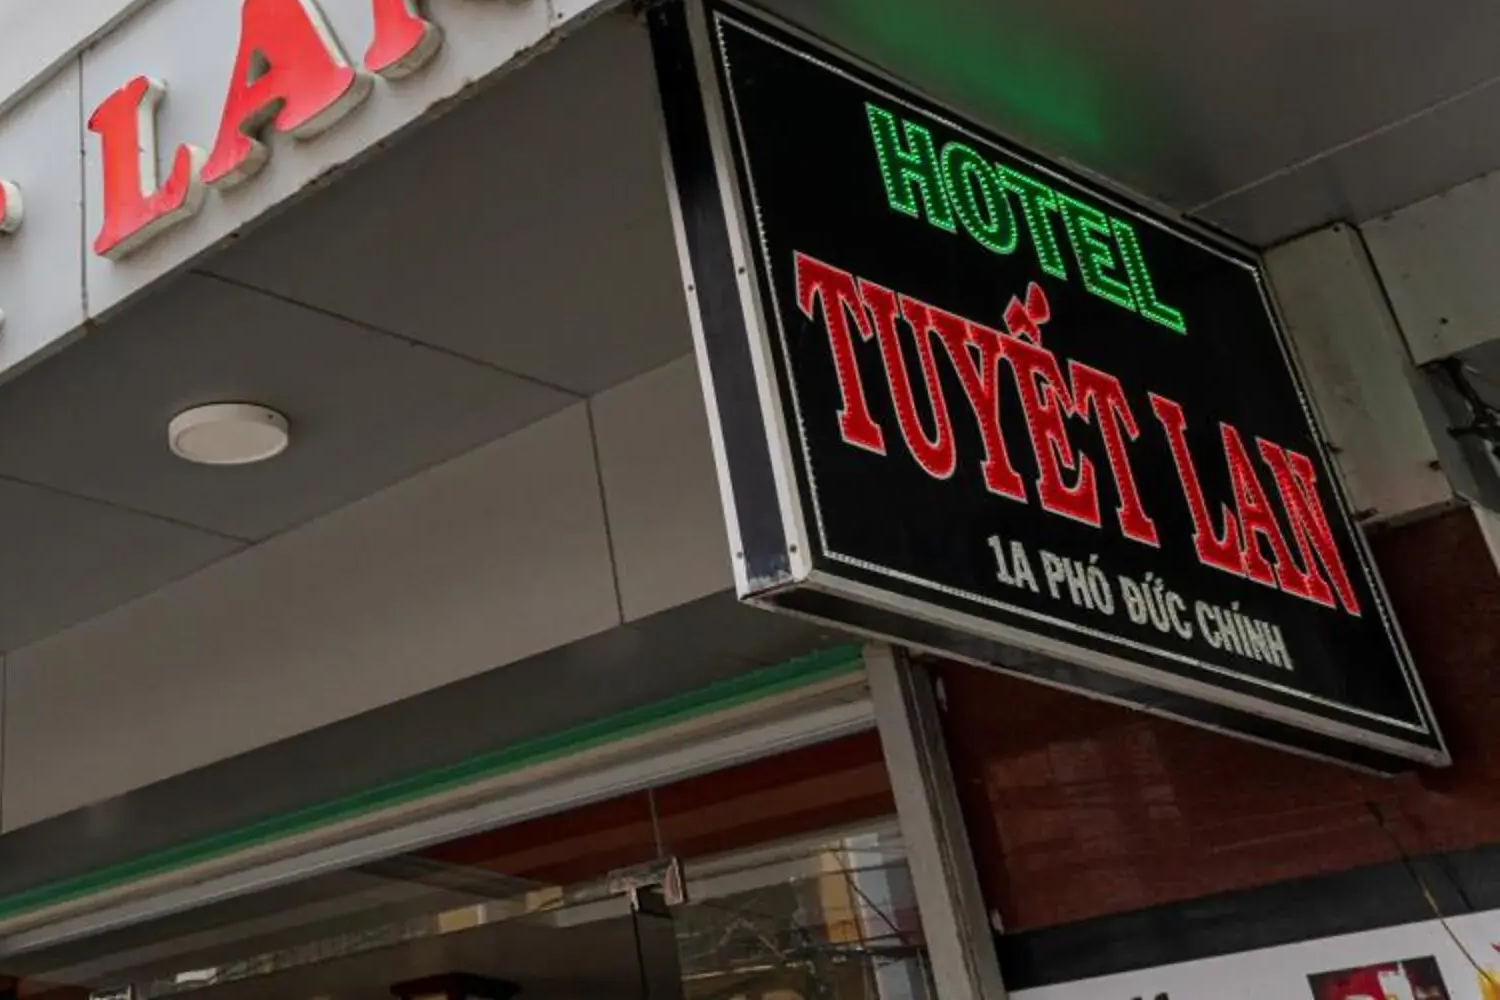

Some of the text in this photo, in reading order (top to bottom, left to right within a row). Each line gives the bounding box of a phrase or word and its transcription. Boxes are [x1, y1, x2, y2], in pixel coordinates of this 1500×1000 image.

[864, 102, 1188, 335] HOTEL
[793, 249, 1363, 616] TUYẾT LAN
[987, 534, 1295, 672] 1A PHÓ ĐỨC CHÍNH
